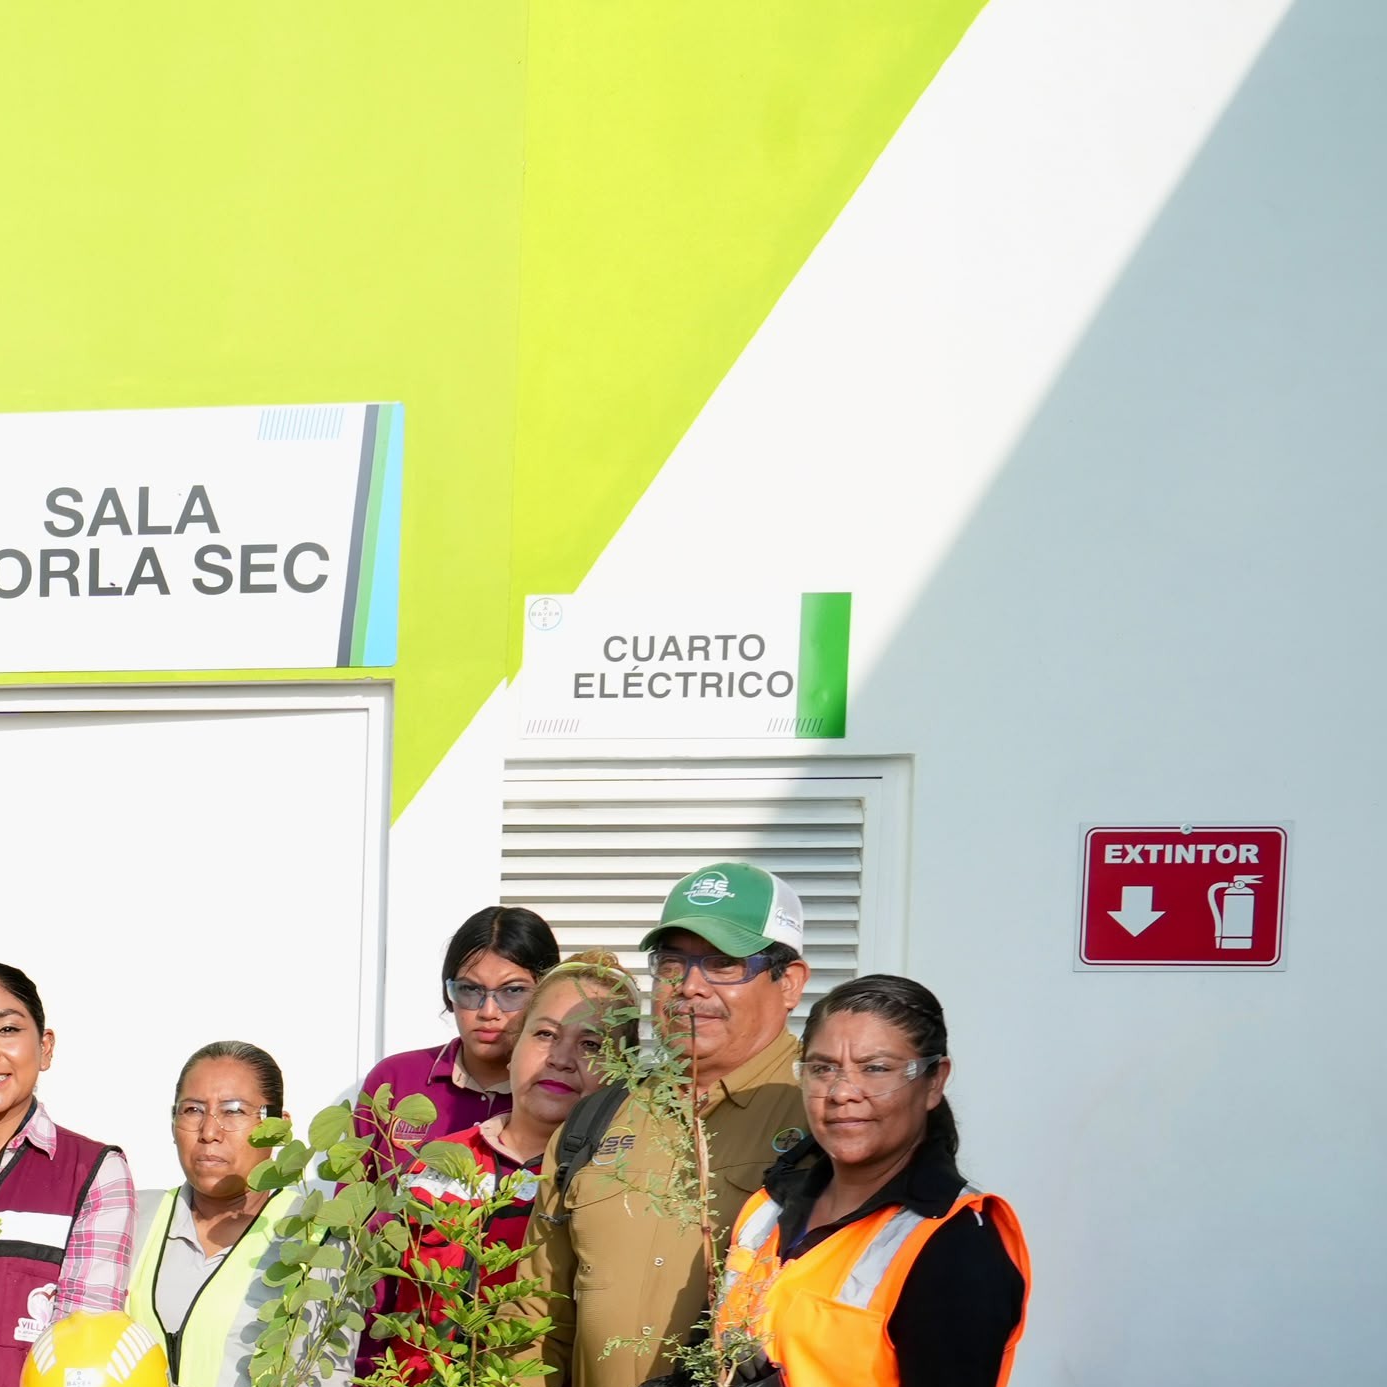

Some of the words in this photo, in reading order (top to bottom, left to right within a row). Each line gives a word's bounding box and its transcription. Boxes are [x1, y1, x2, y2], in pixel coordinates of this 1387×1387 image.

[43, 485, 221, 537] SALA
[192, 542, 330, 595] SEC
[603, 634, 766, 662] CUARTO
[573, 665, 794, 699] ELÉCTRICO
[1104, 844, 1259, 864] EXTINTOR
